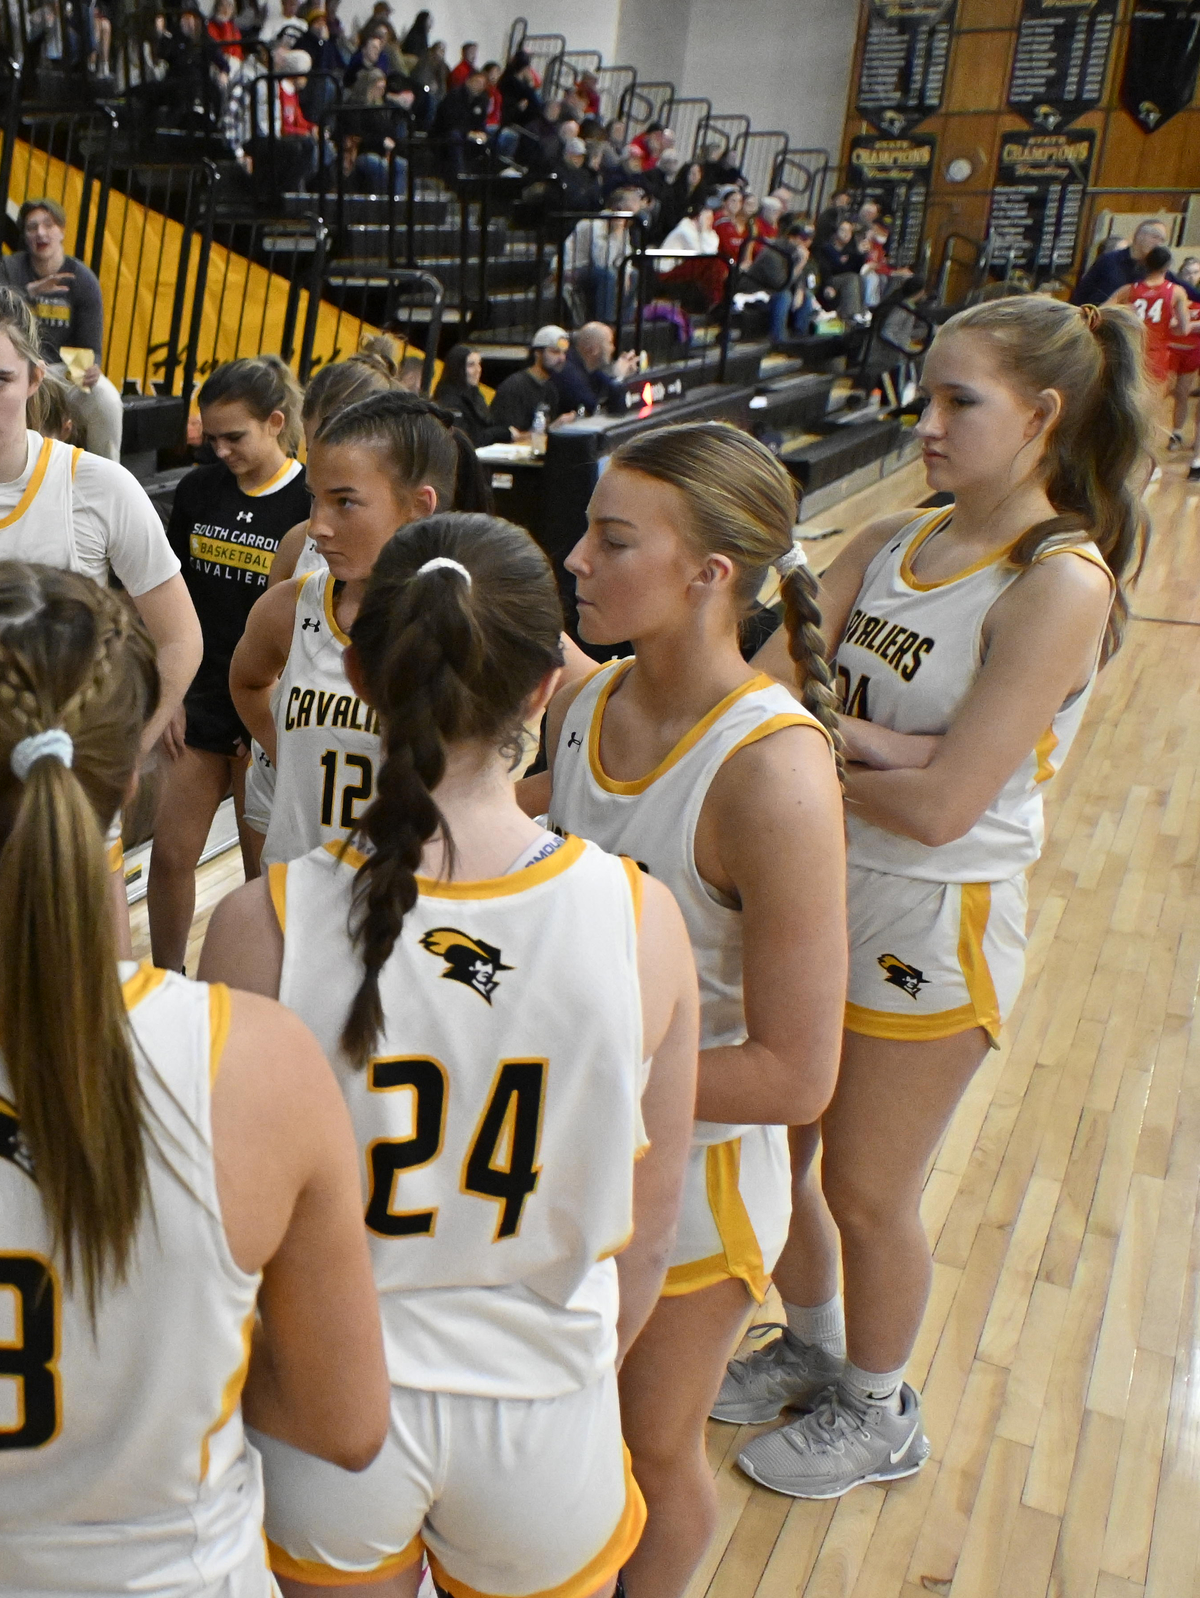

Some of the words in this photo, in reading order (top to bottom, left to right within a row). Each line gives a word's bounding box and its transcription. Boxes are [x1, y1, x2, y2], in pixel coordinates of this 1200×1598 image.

[852, 145, 932, 167] CHAMPIONS
[1003, 141, 1090, 163] CHAMPIONS
[1133, 298, 1164, 323] 34
[192, 522, 230, 541] SOUTH
[200, 542, 269, 570] BASKETBAL
[320, 748, 374, 830] 12
[365, 1053, 550, 1244] 24
